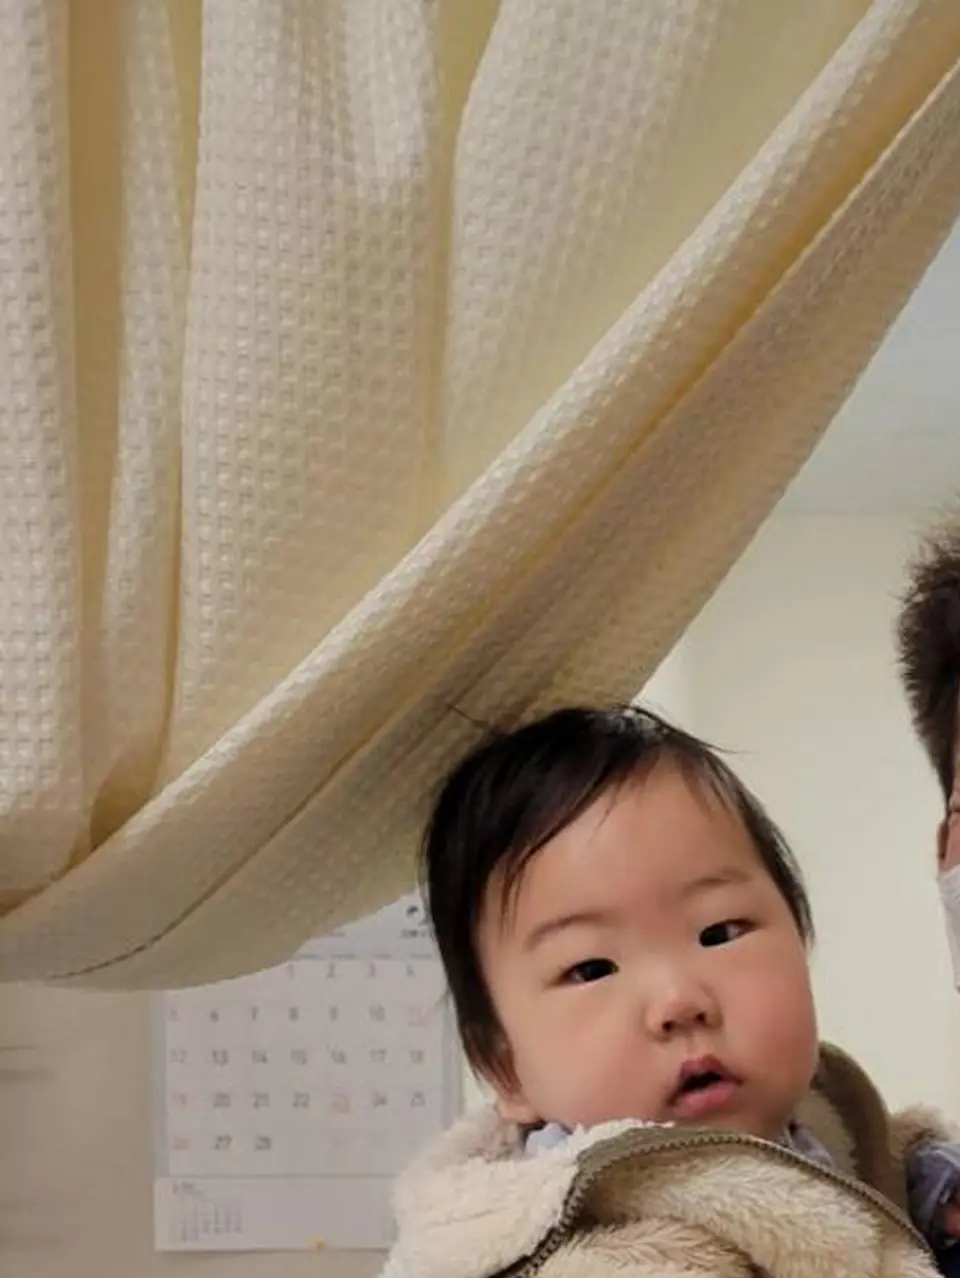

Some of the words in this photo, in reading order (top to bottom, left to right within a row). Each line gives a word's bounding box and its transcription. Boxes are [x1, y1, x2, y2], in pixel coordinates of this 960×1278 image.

[368, 1005, 386, 1021] 10
[370, 1049, 387, 1062] 17
[214, 1134, 233, 1149] 27
